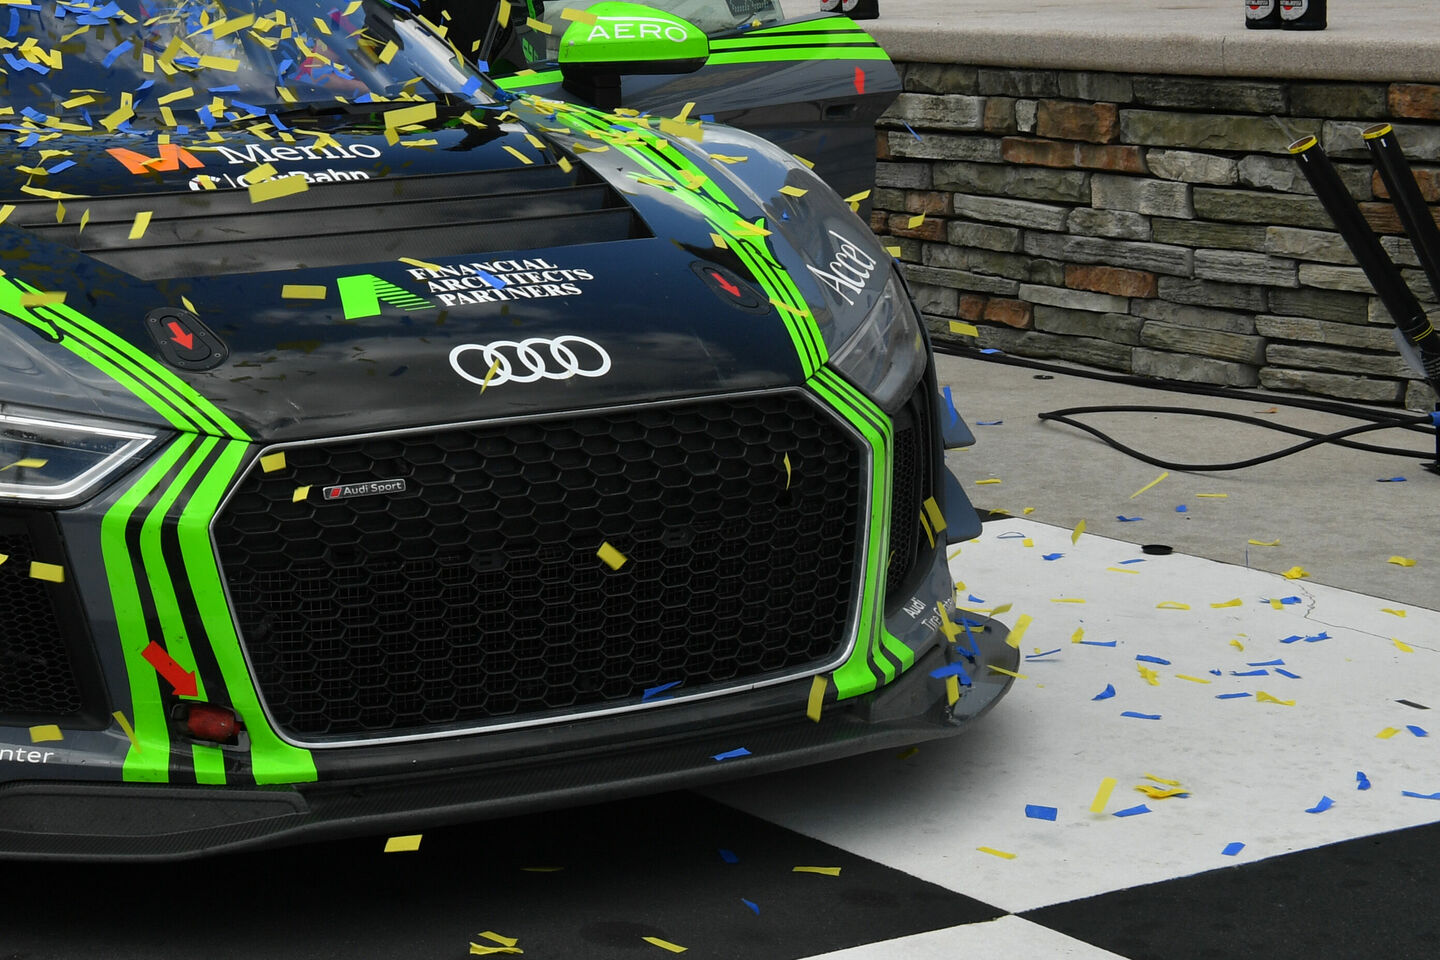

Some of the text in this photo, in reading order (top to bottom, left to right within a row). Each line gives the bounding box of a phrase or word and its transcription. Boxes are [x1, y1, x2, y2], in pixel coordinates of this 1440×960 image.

[587, 23, 687, 43] AERO
[216, 143, 382, 165] Menlo
[406, 258, 558, 280] FINANCIAL
[806, 230, 877, 306] Accel
[427, 268, 594, 293] ARCHITECTS
[436, 282, 582, 307] PARTNERS
[344, 482, 402, 495] Audi Sport
[902, 597, 927, 619] Audi
[921, 614, 940, 632] Tire
